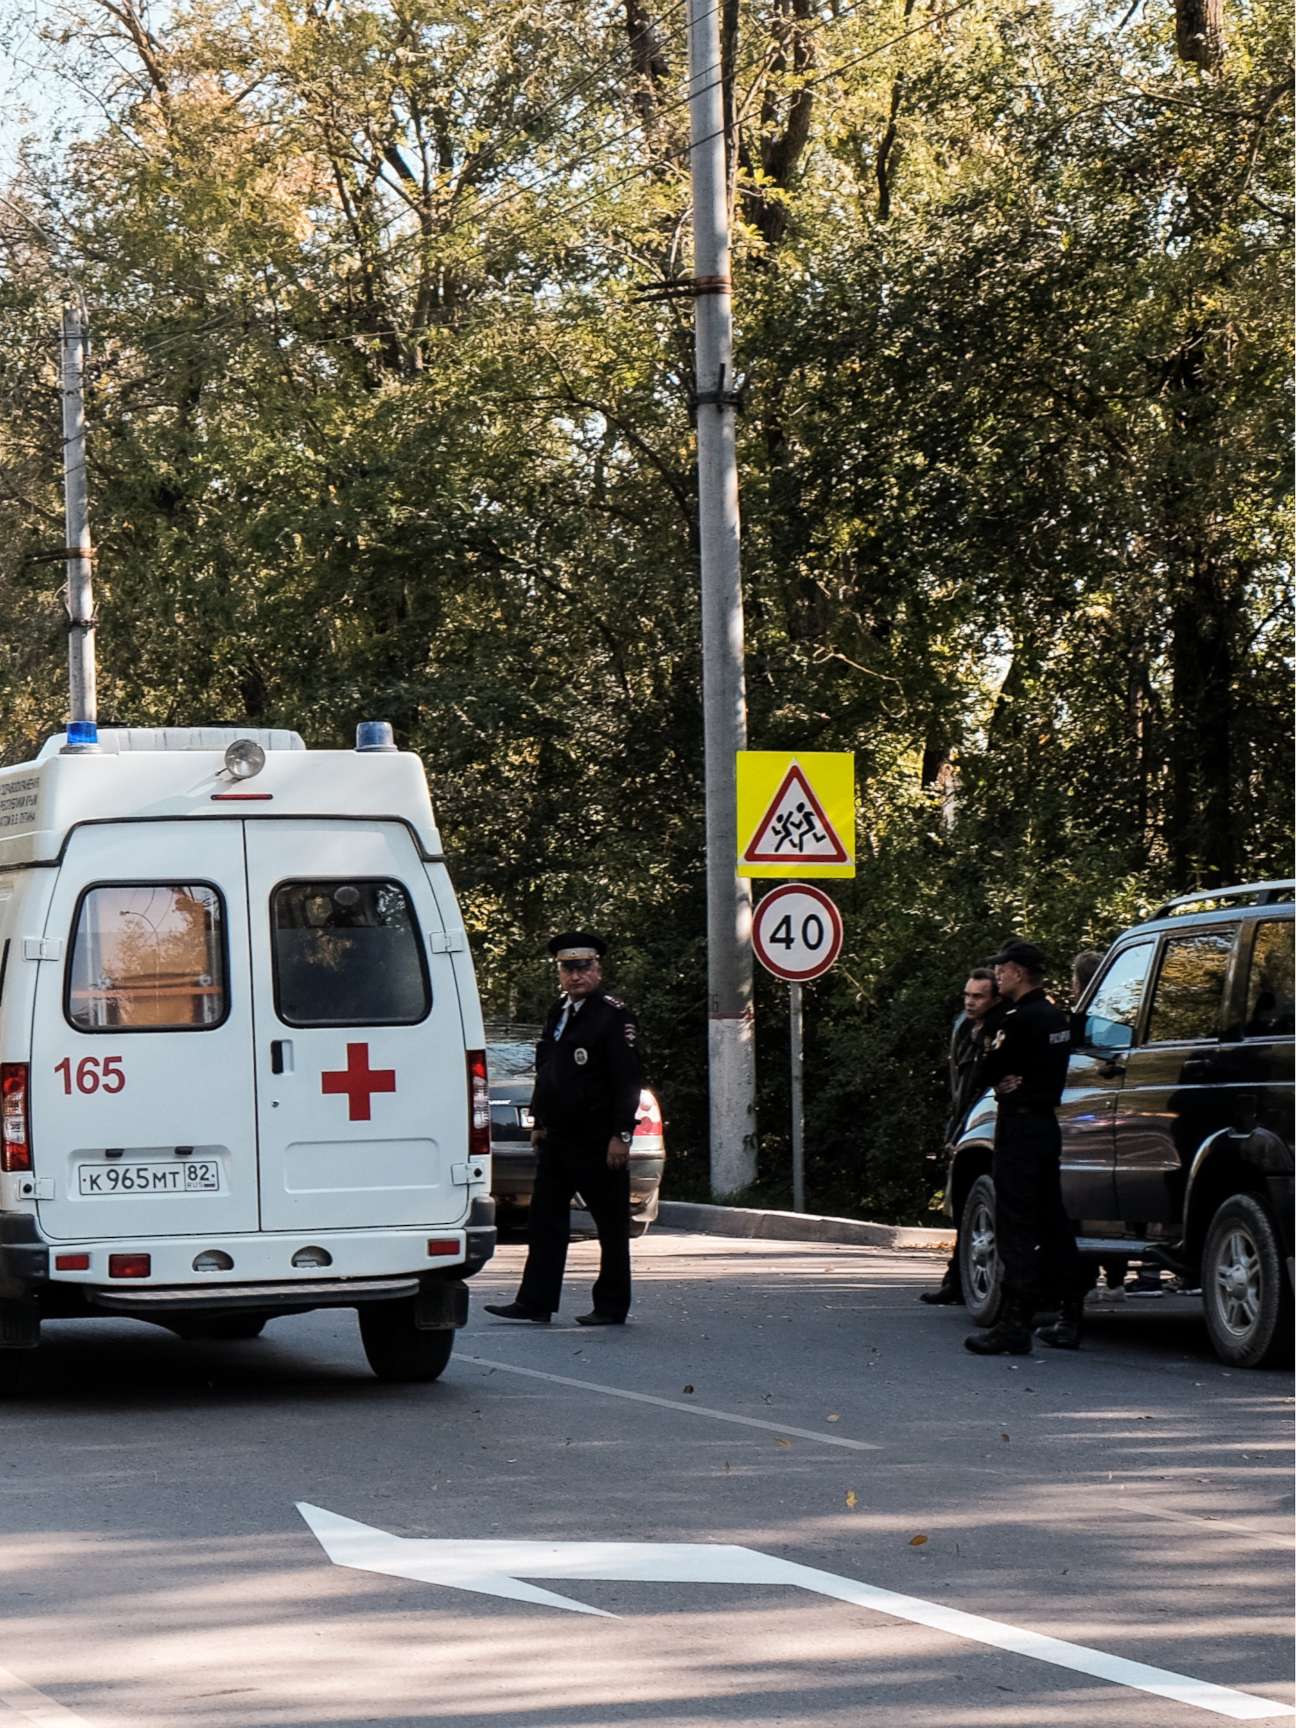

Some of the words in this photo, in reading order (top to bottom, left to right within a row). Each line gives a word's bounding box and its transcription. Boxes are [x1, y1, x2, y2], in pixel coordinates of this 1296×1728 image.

[769, 913, 824, 951] 40
[54, 1056, 126, 1095] 165
[187, 1165, 210, 1181] 82
